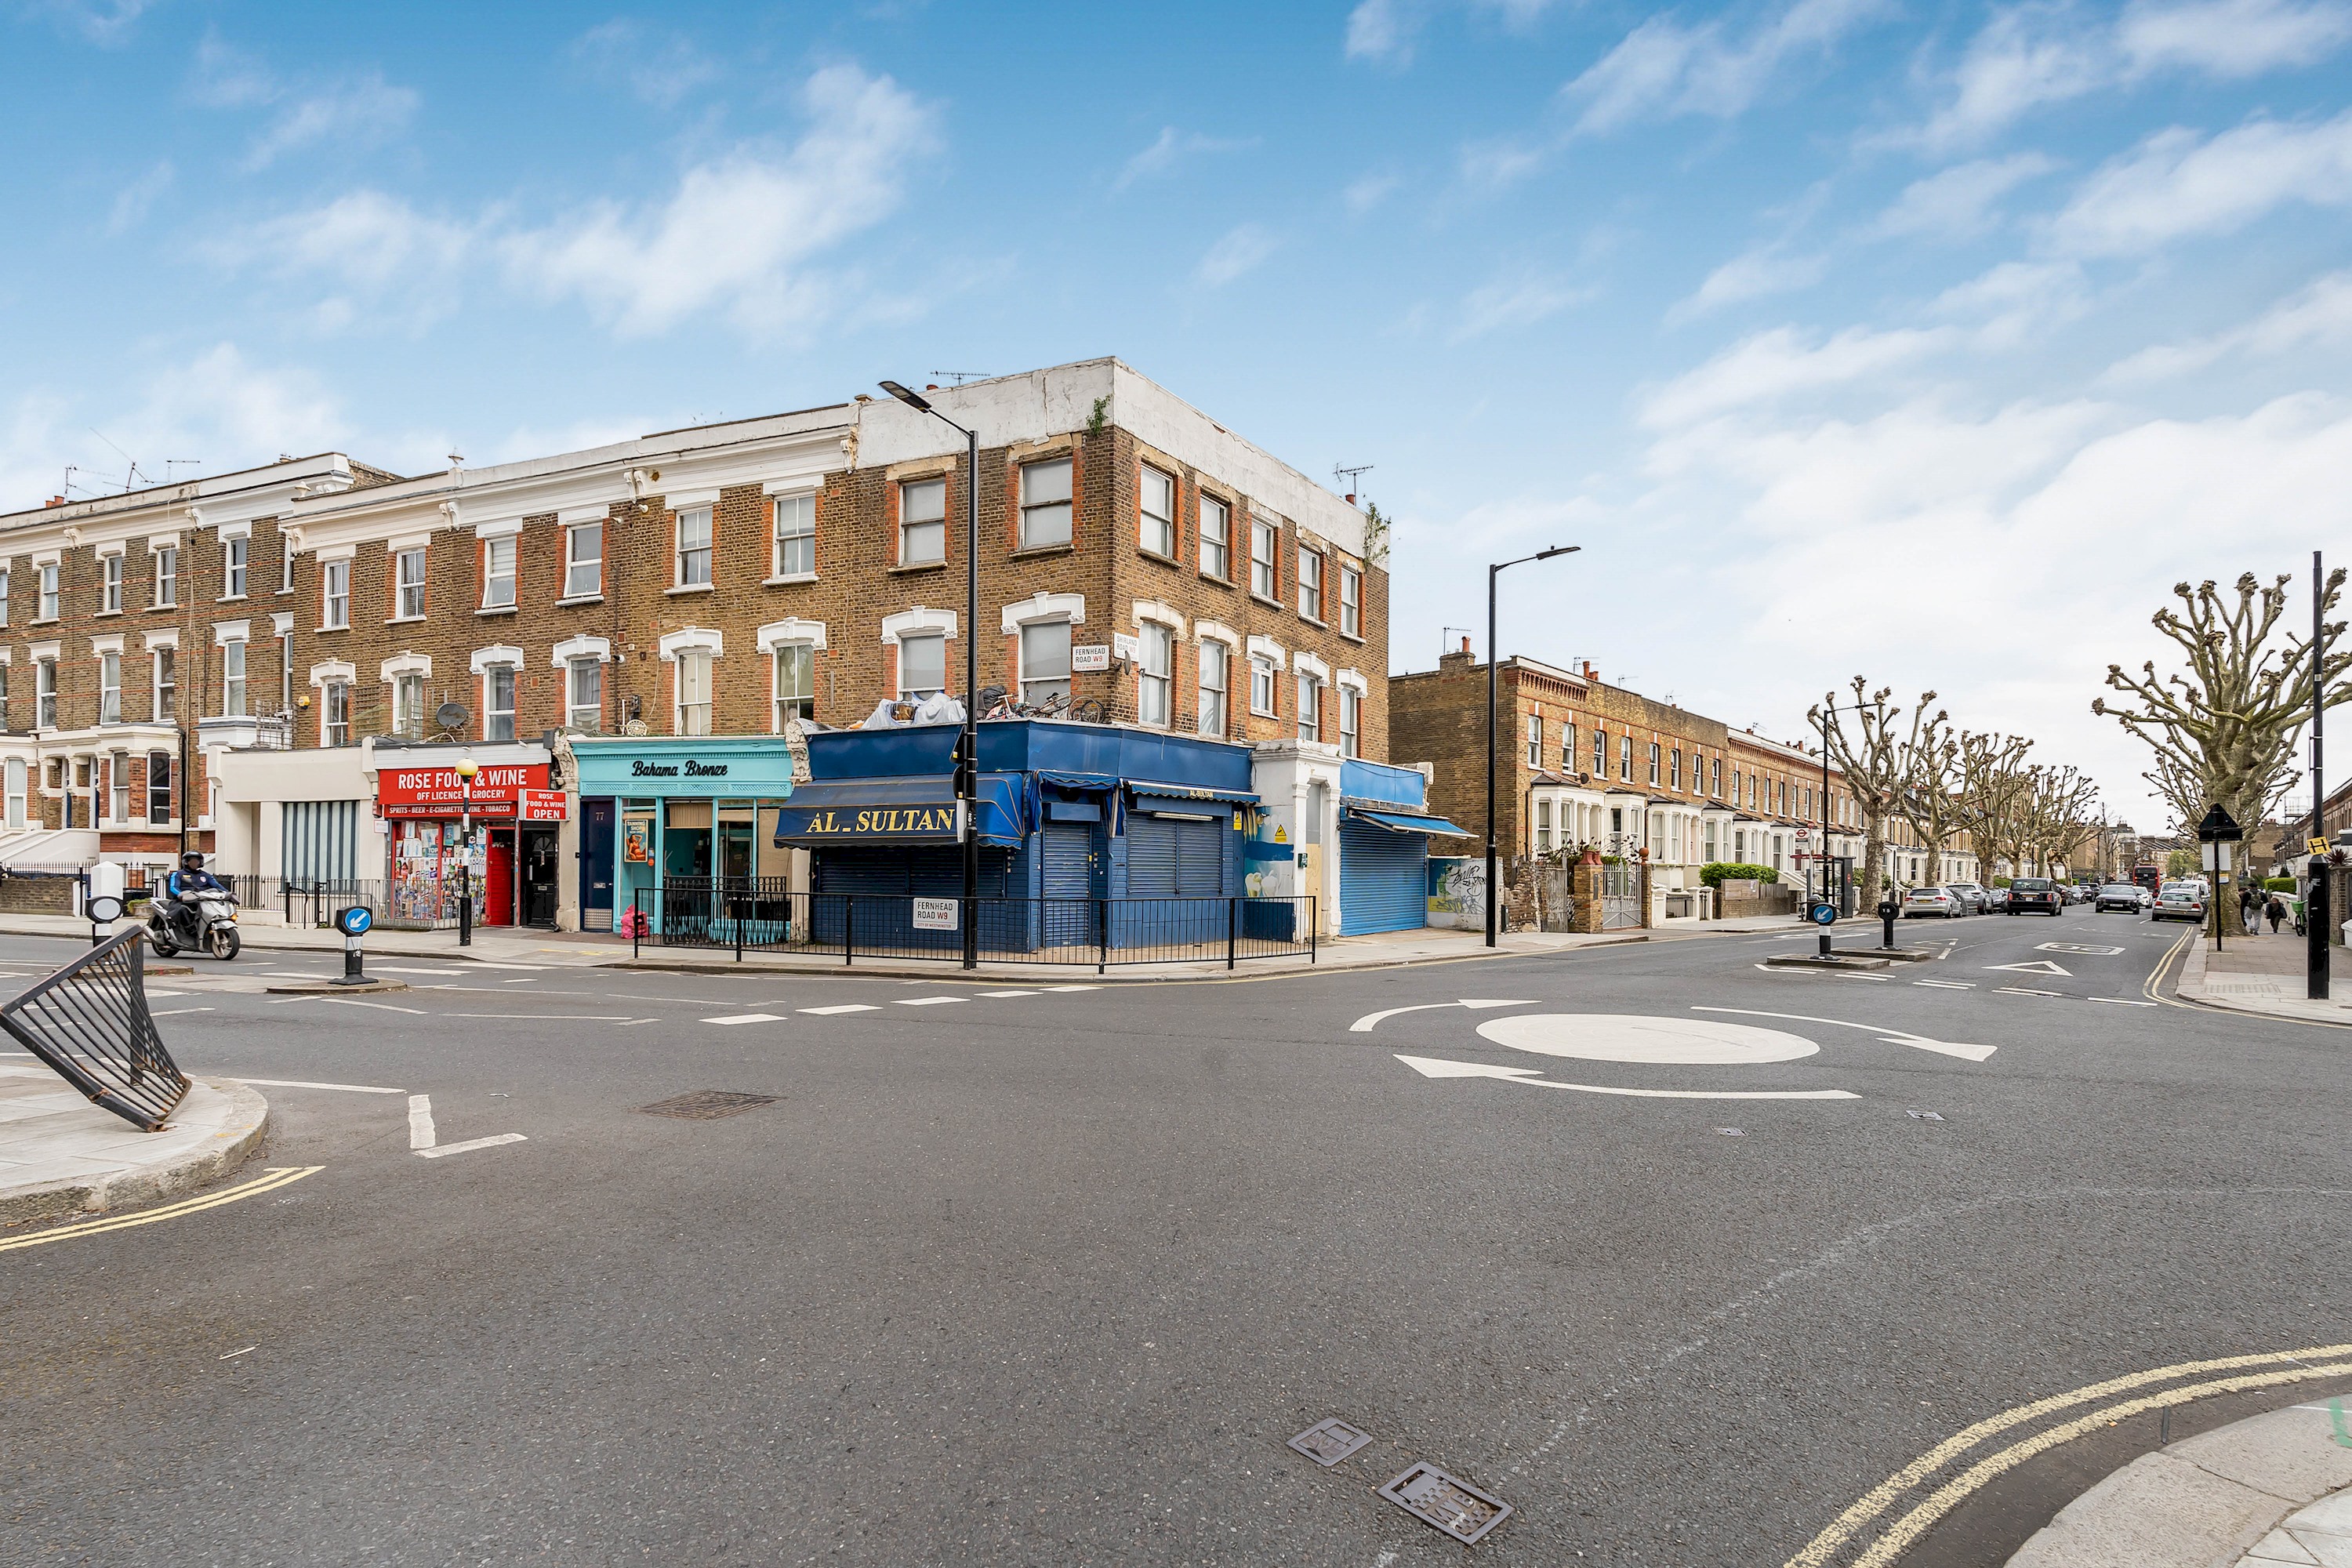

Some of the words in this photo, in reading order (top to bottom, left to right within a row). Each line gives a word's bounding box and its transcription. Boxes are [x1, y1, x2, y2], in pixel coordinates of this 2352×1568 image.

[1116, 635, 1138, 647] SHIRLAND
[631, 760, 678, 776] Bahama
[684, 760, 728, 776] Bronze
[398, 773, 431, 789] ROSE
[435, 771, 464, 788] FOO
[474, 771, 485, 787] &
[488, 768, 527, 786] WINE
[416, 792, 430, 800] OFF
[431, 790, 463, 800] LICENCE
[472, 789, 506, 799] GROCERY
[533, 808, 561, 818] OPEN
[596, 811, 604, 821] 77
[917, 902, 953, 911] FERNHEAD
[917, 910, 935, 920] ROAD
